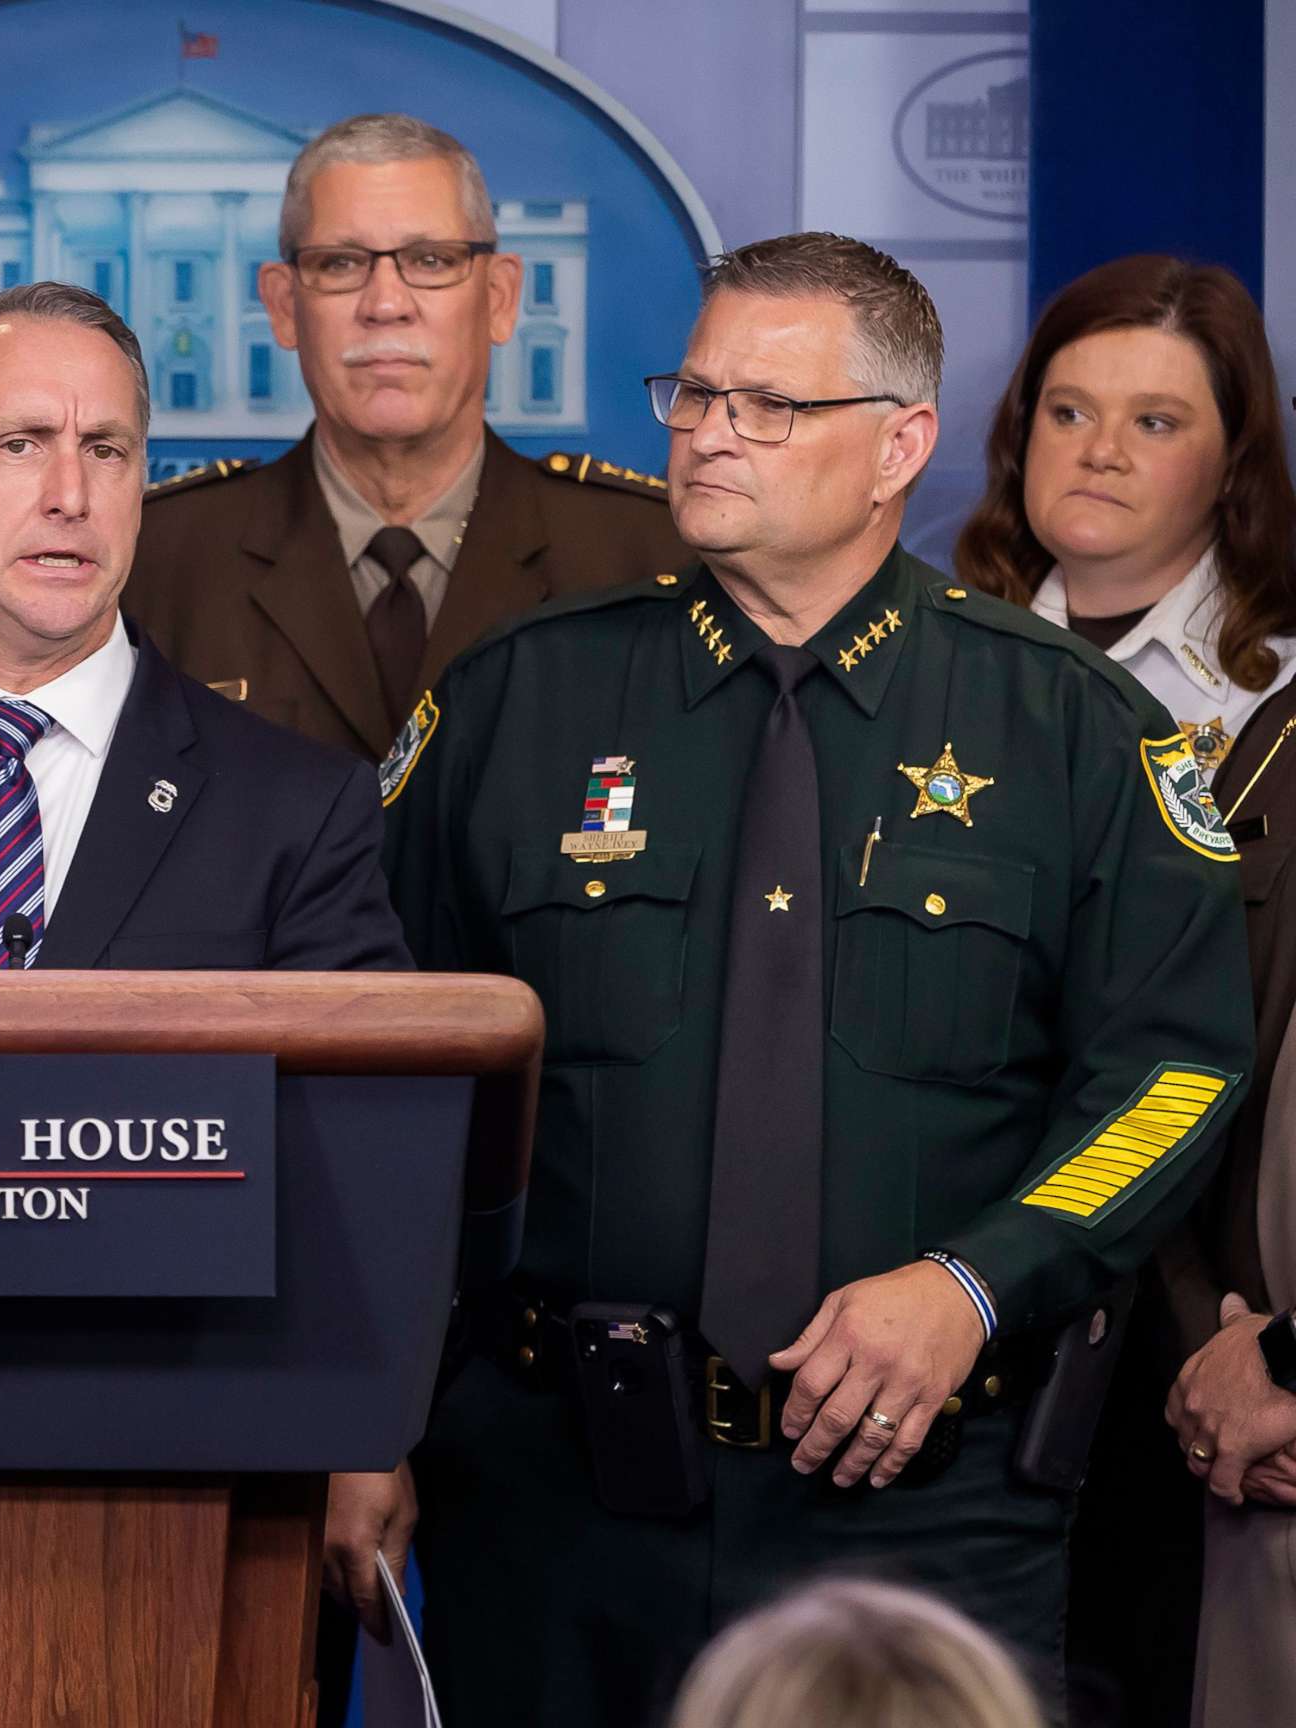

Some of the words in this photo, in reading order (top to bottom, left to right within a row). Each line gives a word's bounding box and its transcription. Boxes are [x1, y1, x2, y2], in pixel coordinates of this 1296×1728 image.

[936, 168, 969, 184] THE
[584, 832, 625, 841] SHERIFF
[21, 1117, 228, 1162] HOUSE
